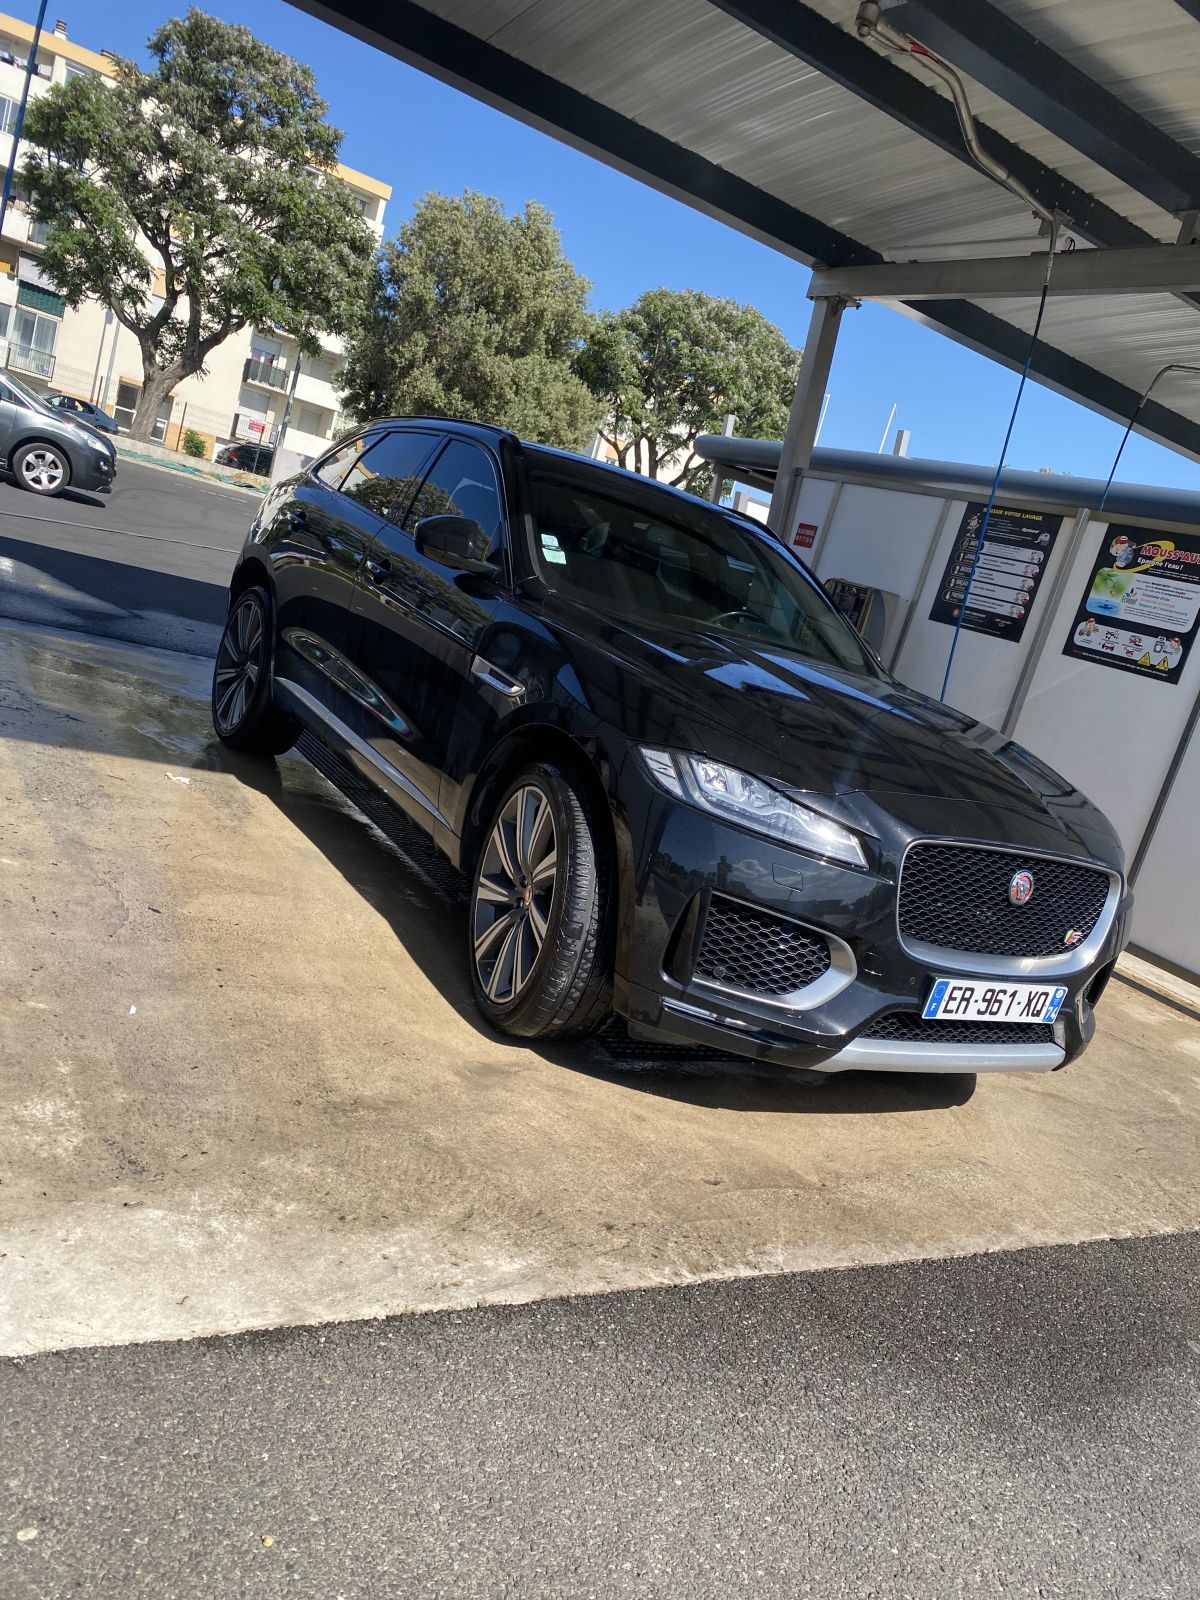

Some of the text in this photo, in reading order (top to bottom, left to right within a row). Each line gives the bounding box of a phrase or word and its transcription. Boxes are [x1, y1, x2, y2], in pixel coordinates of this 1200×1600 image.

[1004, 510, 1022, 518] VOTRE
[1022, 513, 1043, 521] LAVAGE
[930, 1002, 937, 1012] F
[942, 986, 1049, 1018] ER-961-XQ
